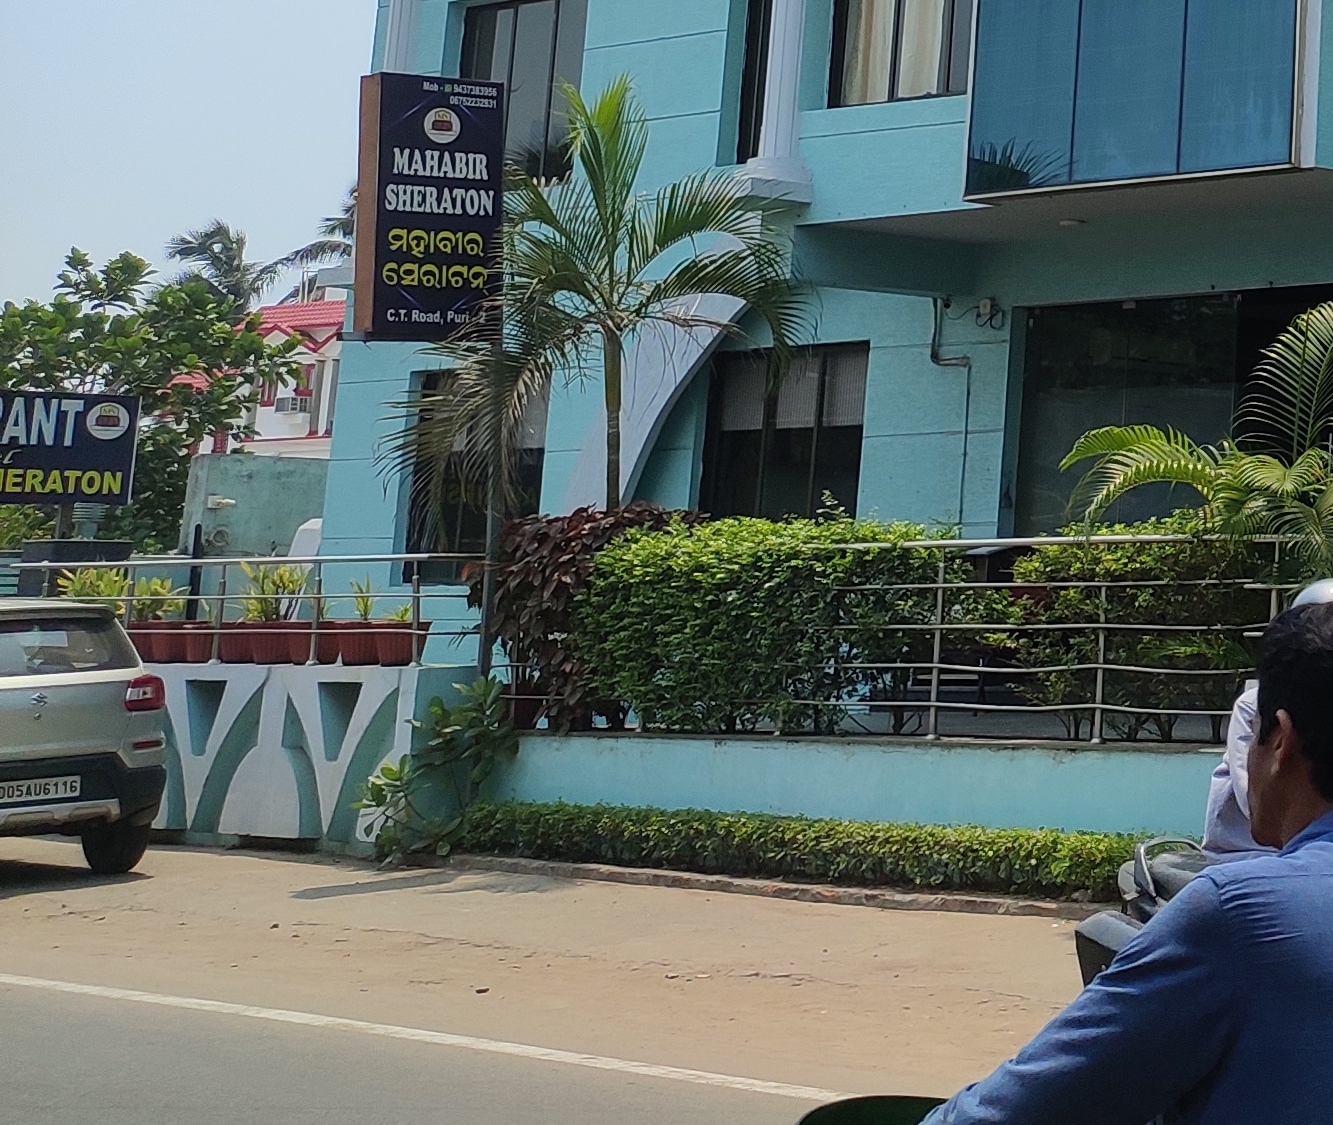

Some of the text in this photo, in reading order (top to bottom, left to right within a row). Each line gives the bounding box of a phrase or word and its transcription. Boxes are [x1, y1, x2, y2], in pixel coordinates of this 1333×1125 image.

[423, 81, 439, 92] Mob
[393, 147, 489, 180] MAHABIR
[385, 184, 494, 216] SHERATON
[388, 228, 484, 258] ମହାବୀର
[386, 308, 408, 322] C.T.
[411, 309, 444, 325] Road,
[446, 310, 470, 323] Puri
[0, 396, 85, 447] ANT
